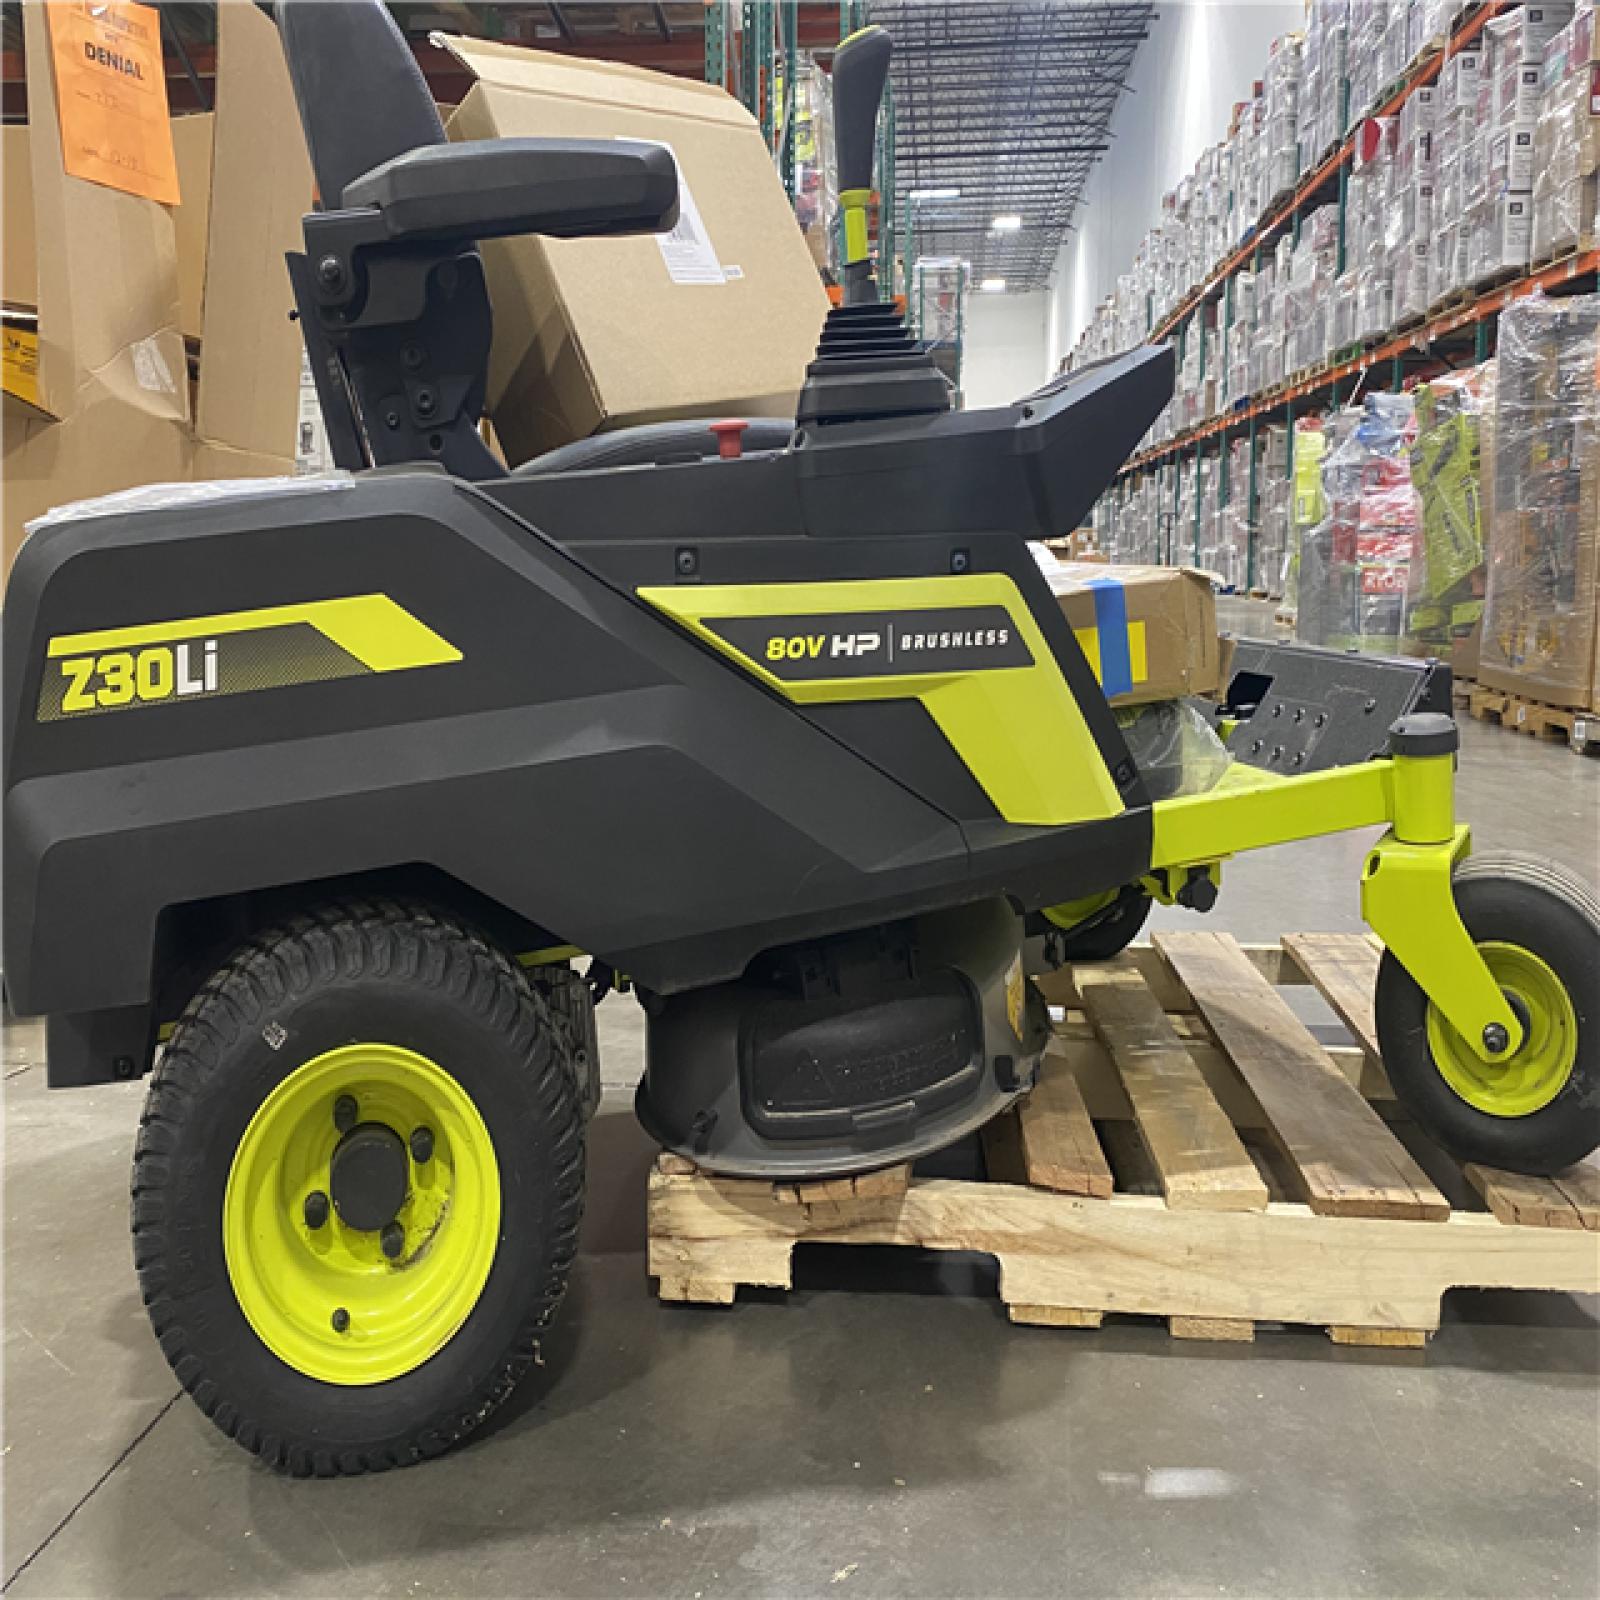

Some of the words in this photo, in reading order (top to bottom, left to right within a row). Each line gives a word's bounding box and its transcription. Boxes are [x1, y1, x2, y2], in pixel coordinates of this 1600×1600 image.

[85, 42, 144, 80] DENIAL
[766, 635, 825, 660] 80V
[830, 634, 881, 657] HP
[901, 629, 1009, 650] BRUSHLESS
[61, 640, 218, 711] Z30Li
